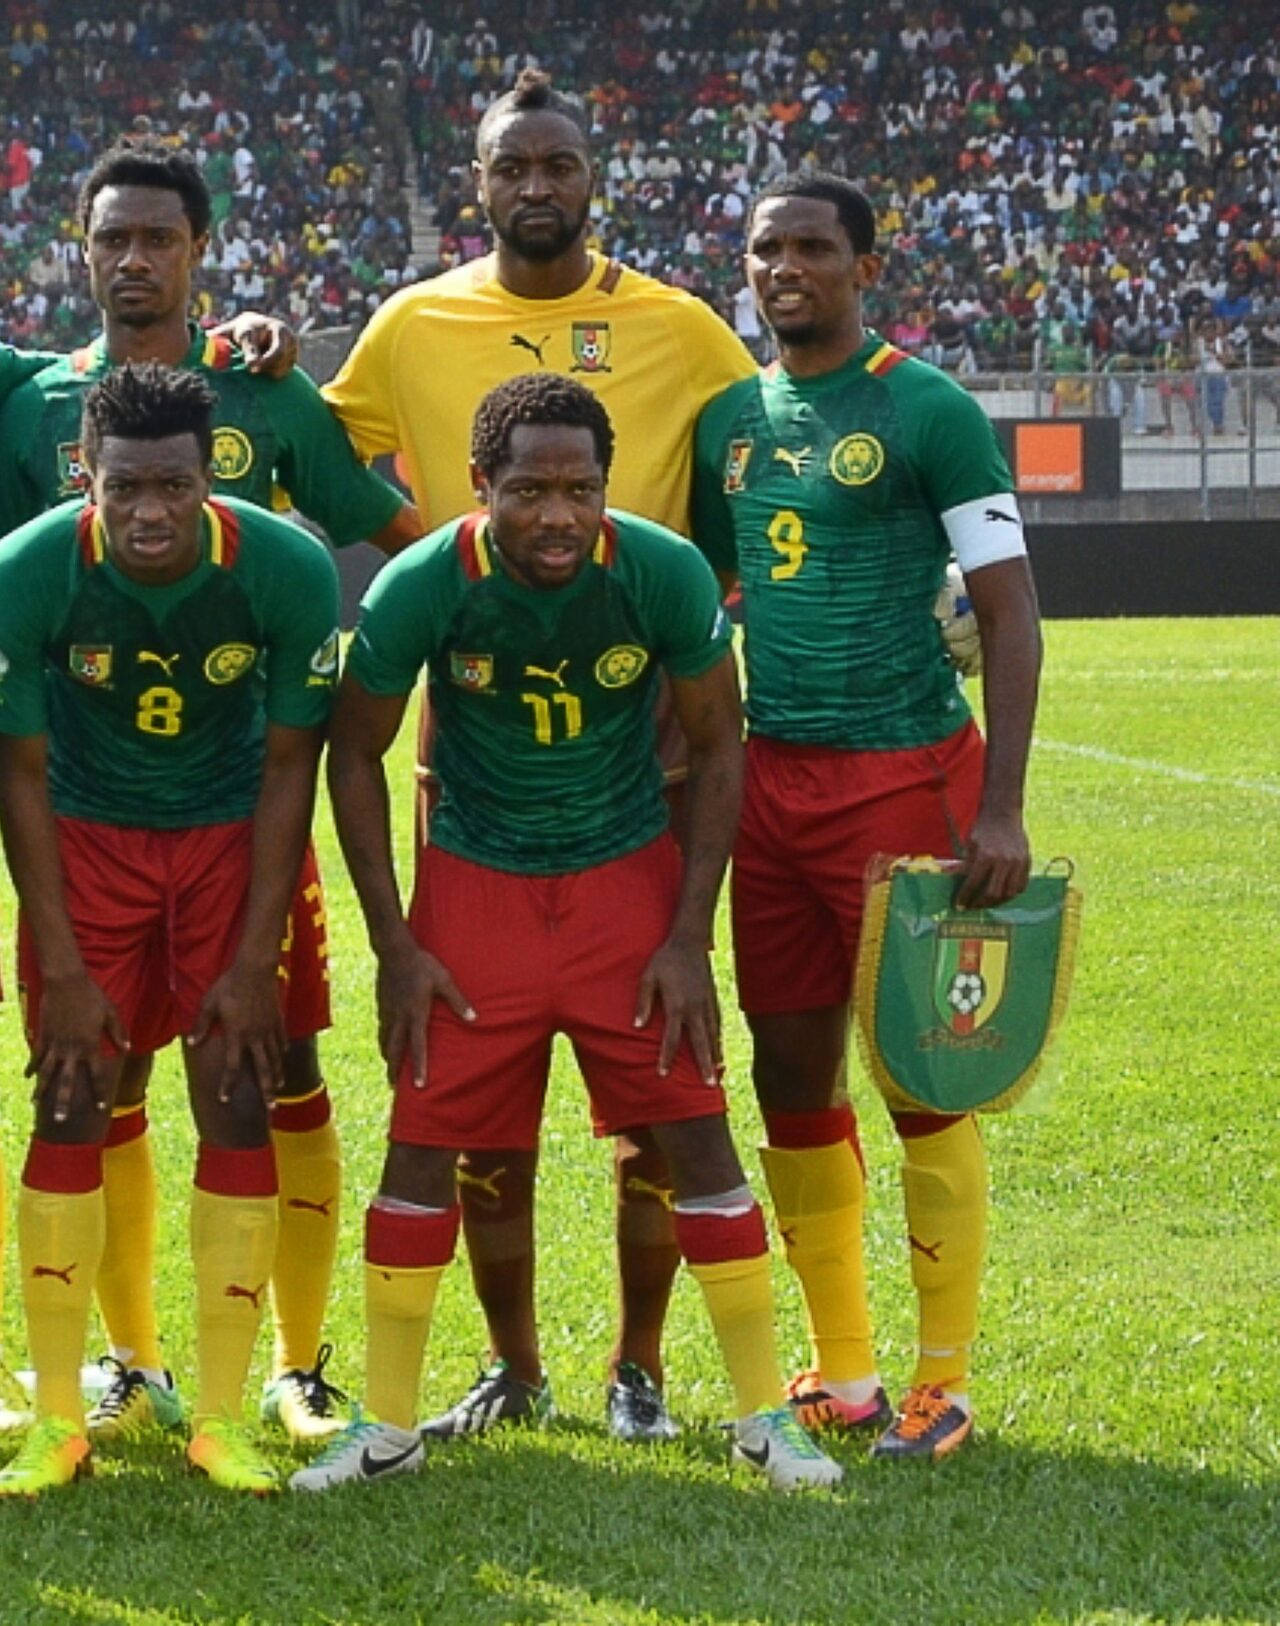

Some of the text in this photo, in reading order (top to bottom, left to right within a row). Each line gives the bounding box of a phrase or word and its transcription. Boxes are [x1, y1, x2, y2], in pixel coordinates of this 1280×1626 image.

[768, 511, 807, 579] 9
[137, 686, 182, 735] 8
[523, 693, 582, 745] 11
